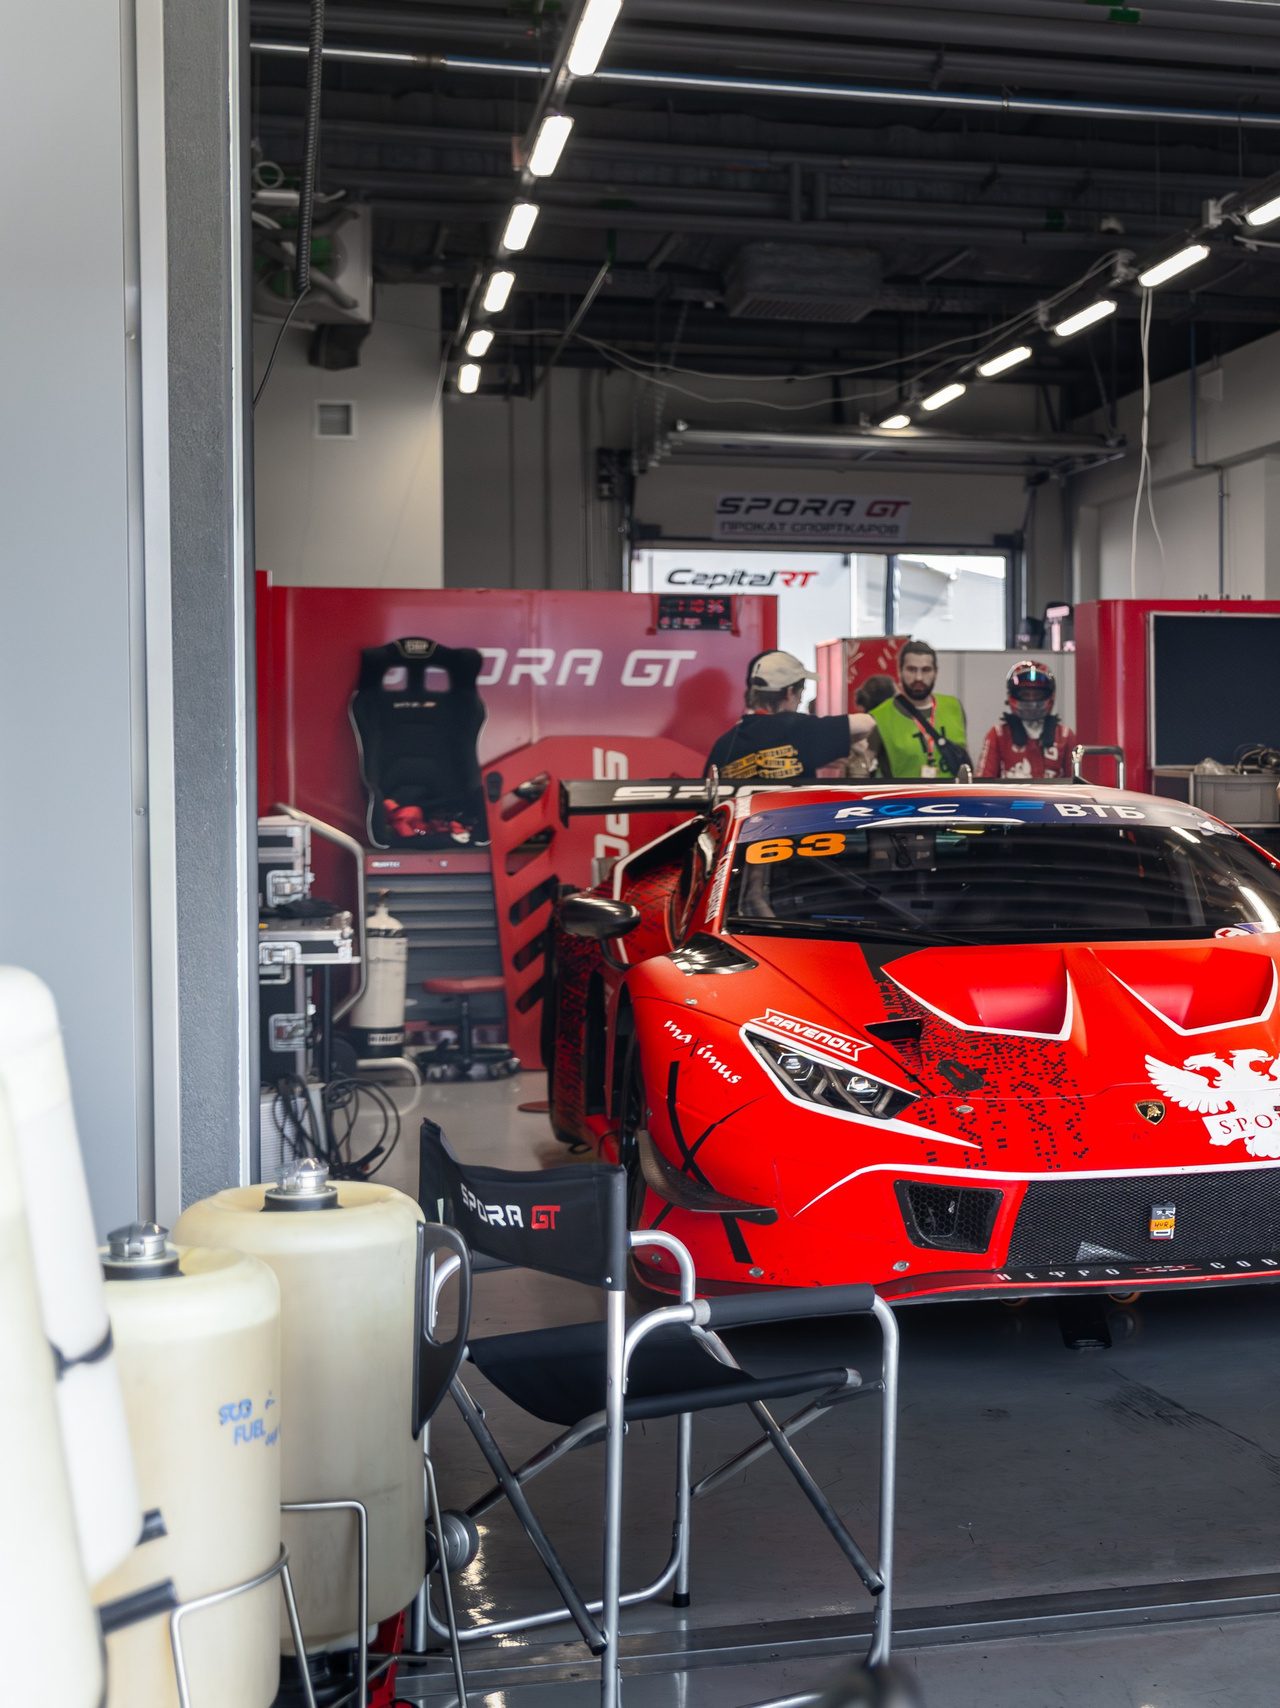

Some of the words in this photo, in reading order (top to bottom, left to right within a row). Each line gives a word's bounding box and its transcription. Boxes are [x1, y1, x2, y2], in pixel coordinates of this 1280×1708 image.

[716, 497, 856, 517] SPORA
[865, 499, 911, 518] GT
[721, 520, 788, 533] ПРОКАТ
[790, 522, 899, 534] СПОРТКАРОВ
[667, 569, 819, 589] CapitalRT
[620, 650, 697, 687] GT
[745, 833, 847, 864] 63
[765, 1015, 858, 1053] RAVENOL
[460, 1182, 524, 1228] SPORA
[531, 1205, 561, 1230] GT
